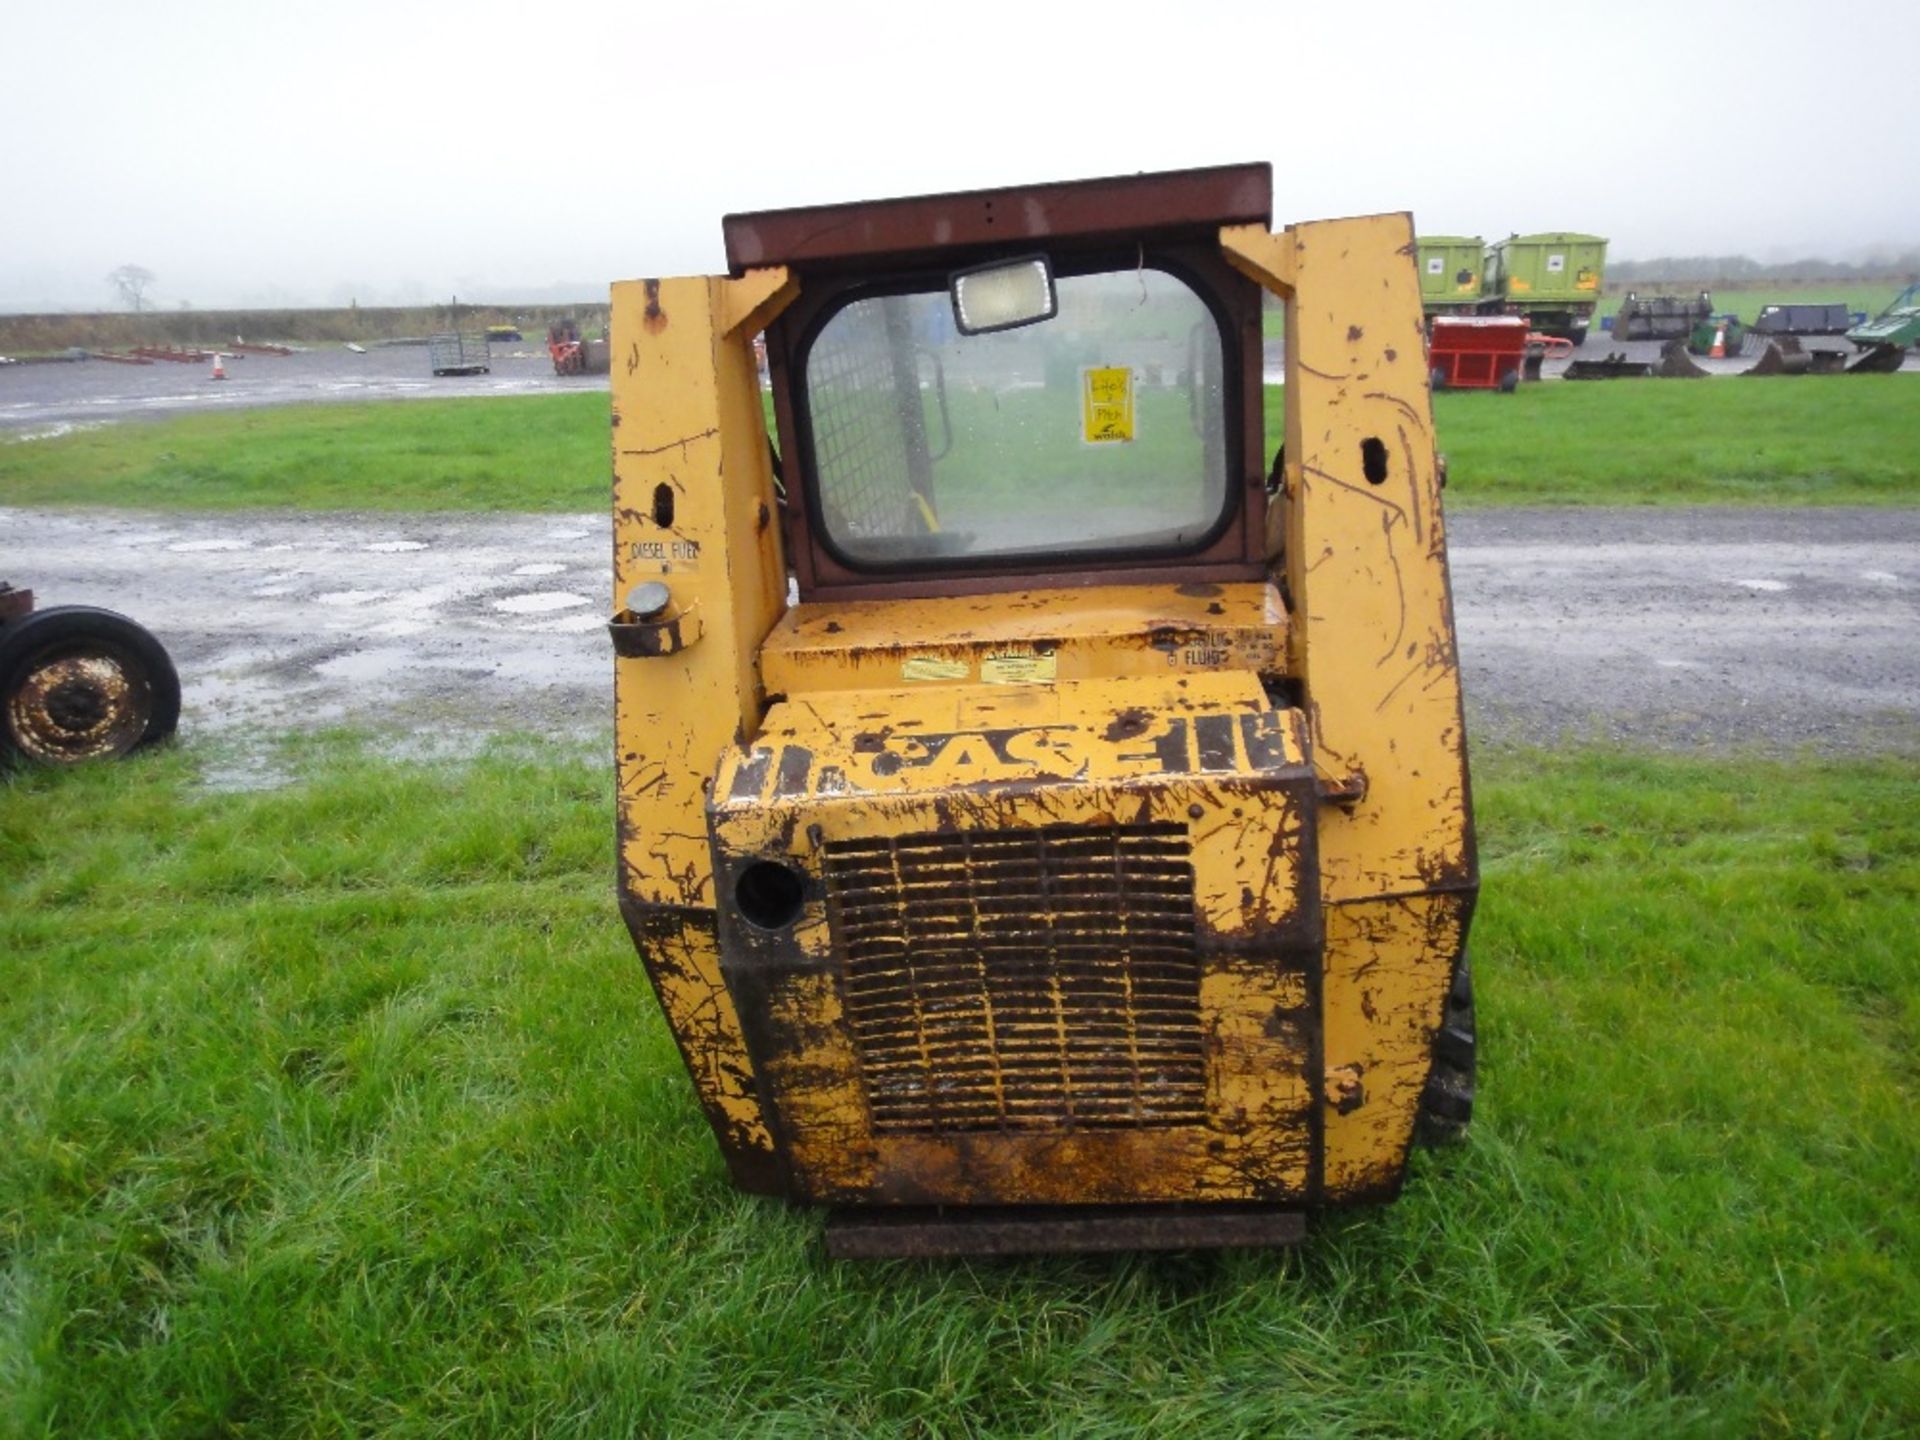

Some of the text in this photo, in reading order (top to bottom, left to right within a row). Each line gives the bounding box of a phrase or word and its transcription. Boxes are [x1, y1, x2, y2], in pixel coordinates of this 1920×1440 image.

[631, 541, 699, 559] DIESEL FUEL
[848, 721, 1162, 789] CASE
